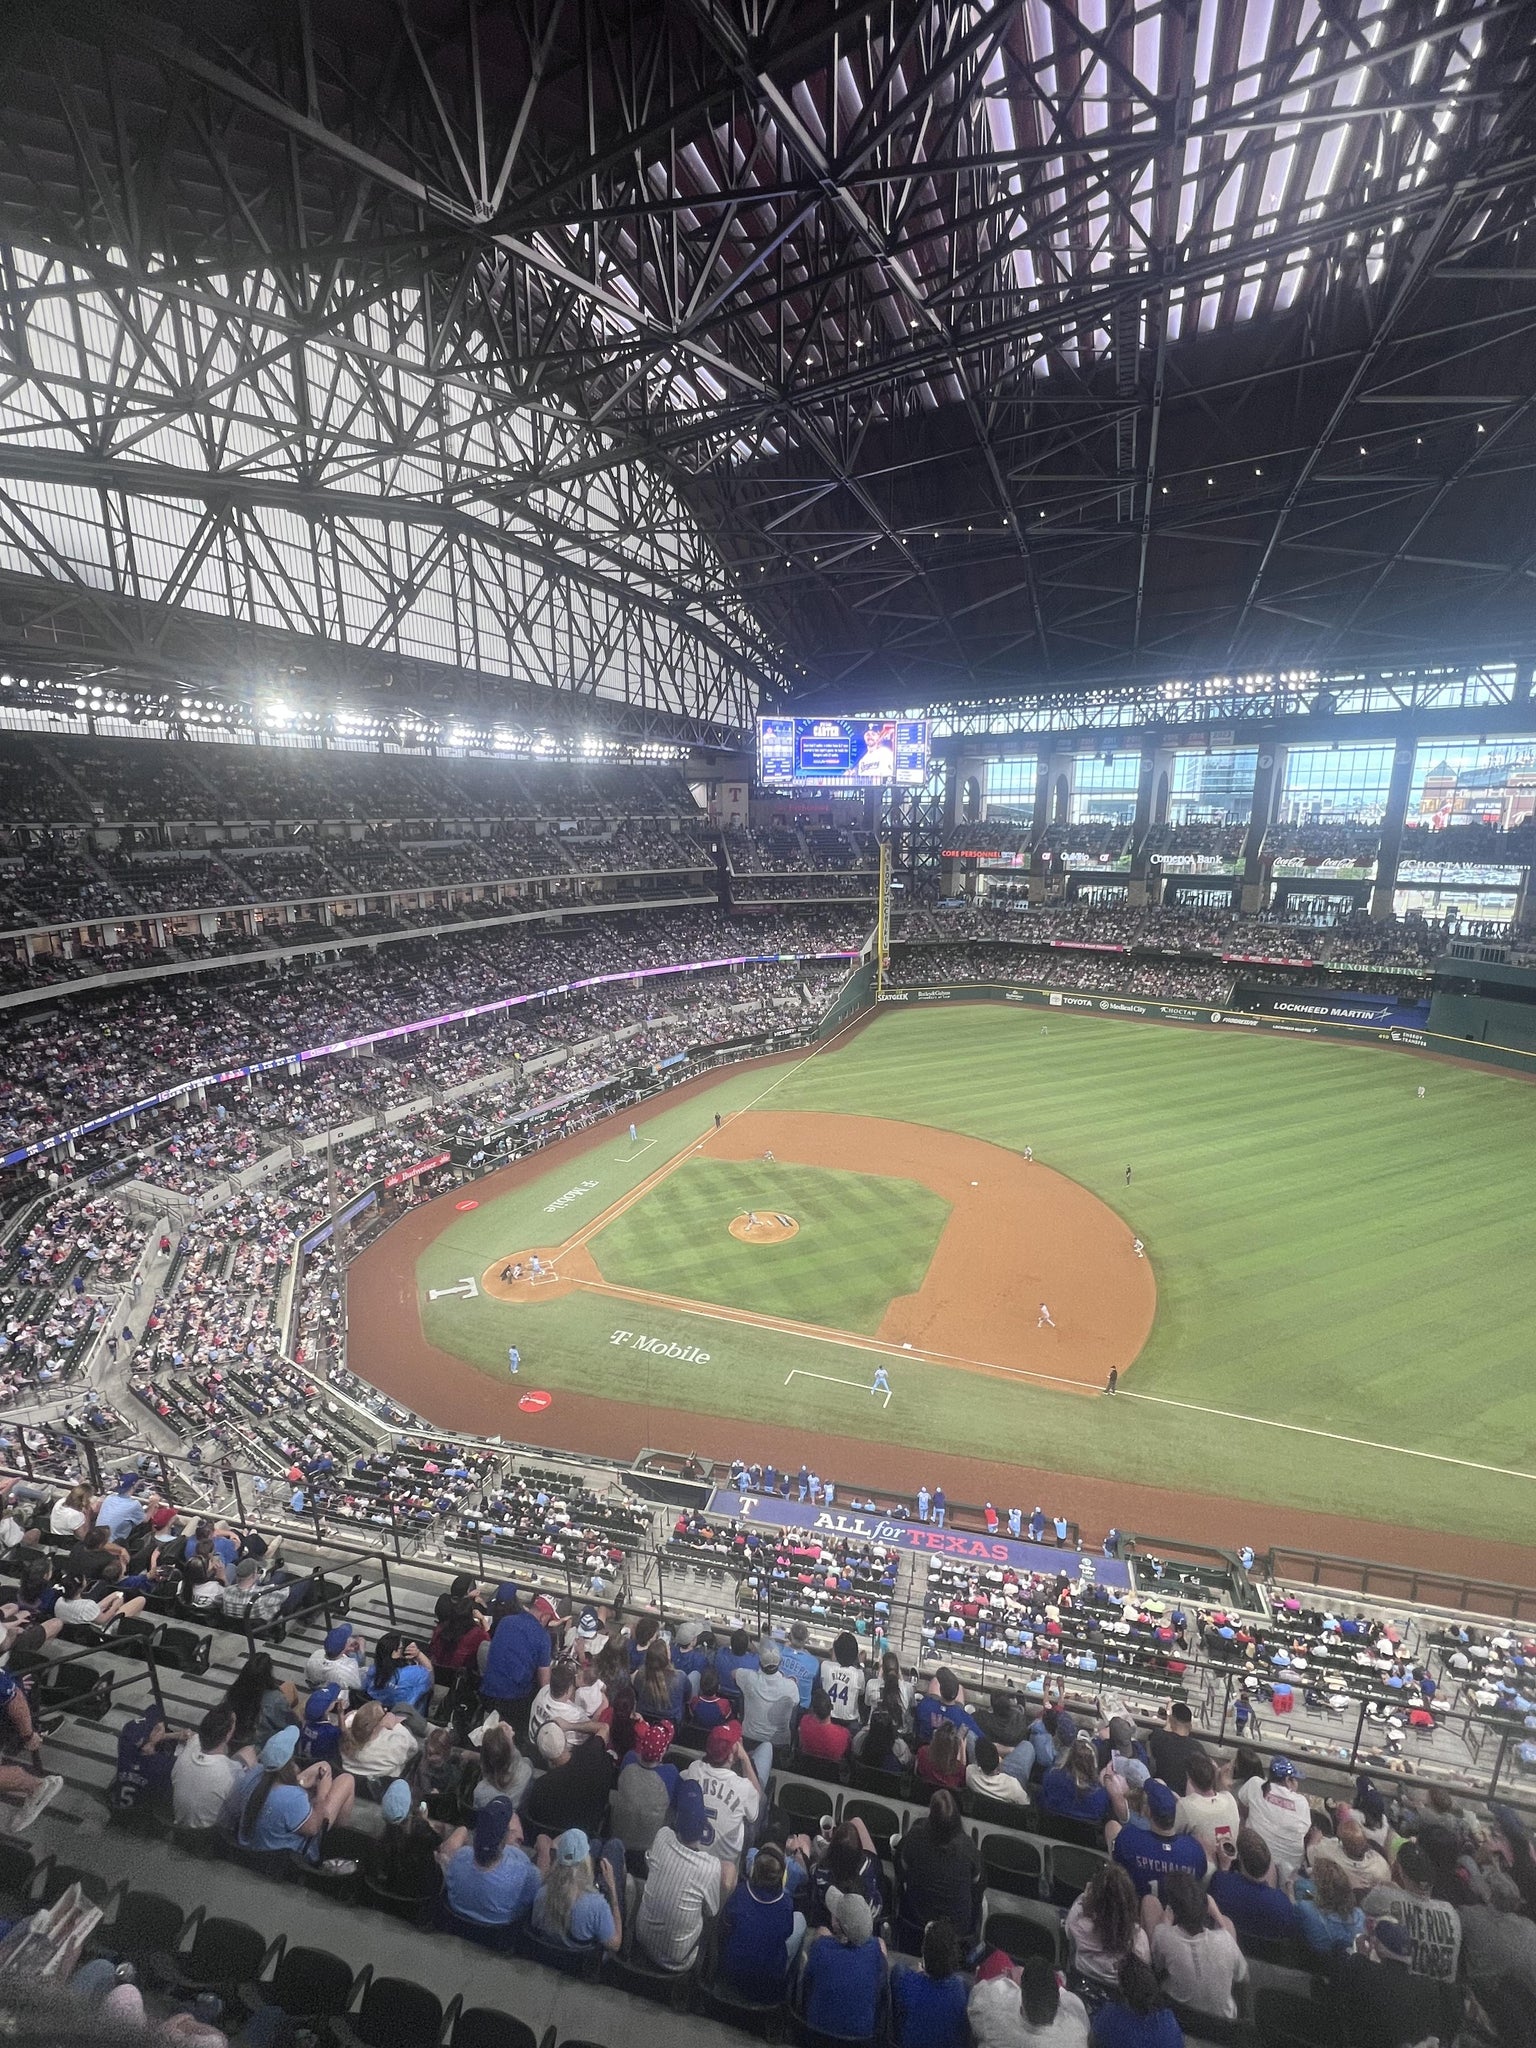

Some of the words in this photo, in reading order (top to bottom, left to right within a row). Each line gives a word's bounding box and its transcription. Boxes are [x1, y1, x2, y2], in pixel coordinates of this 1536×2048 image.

[728, 788, 741, 802] T
[960, 850, 1001, 858] PERSONNEL
[1197, 855, 1223, 864] Bank
[1407, 860, 1474, 870] CHOCTAW
[1334, 963, 1369, 972] LUXOR
[1371, 965, 1423, 976] STAFFING
[1063, 997, 1093, 1007] TOYOTA
[1109, 1003, 1132, 1012] Medical
[1132, 1005, 1147, 1014] City
[1163, 1007, 1197, 1016] CHOCTAW
[1273, 1002, 1329, 1015] LOCKHEED
[1330, 1006, 1375, 1020] MARTIN
[402, 1161, 437, 1180] Budweiser
[543, 1186, 591, 1213] Mobile
[428, 1276, 479, 1301] T
[629, 1334, 711, 1366] Mobile
[738, 1496, 760, 1515] T
[813, 1512, 872, 1537] ALL
[871, 1521, 906, 1542] for
[906, 1528, 1009, 1562] TEXAS
[828, 1682, 849, 1706] 44
